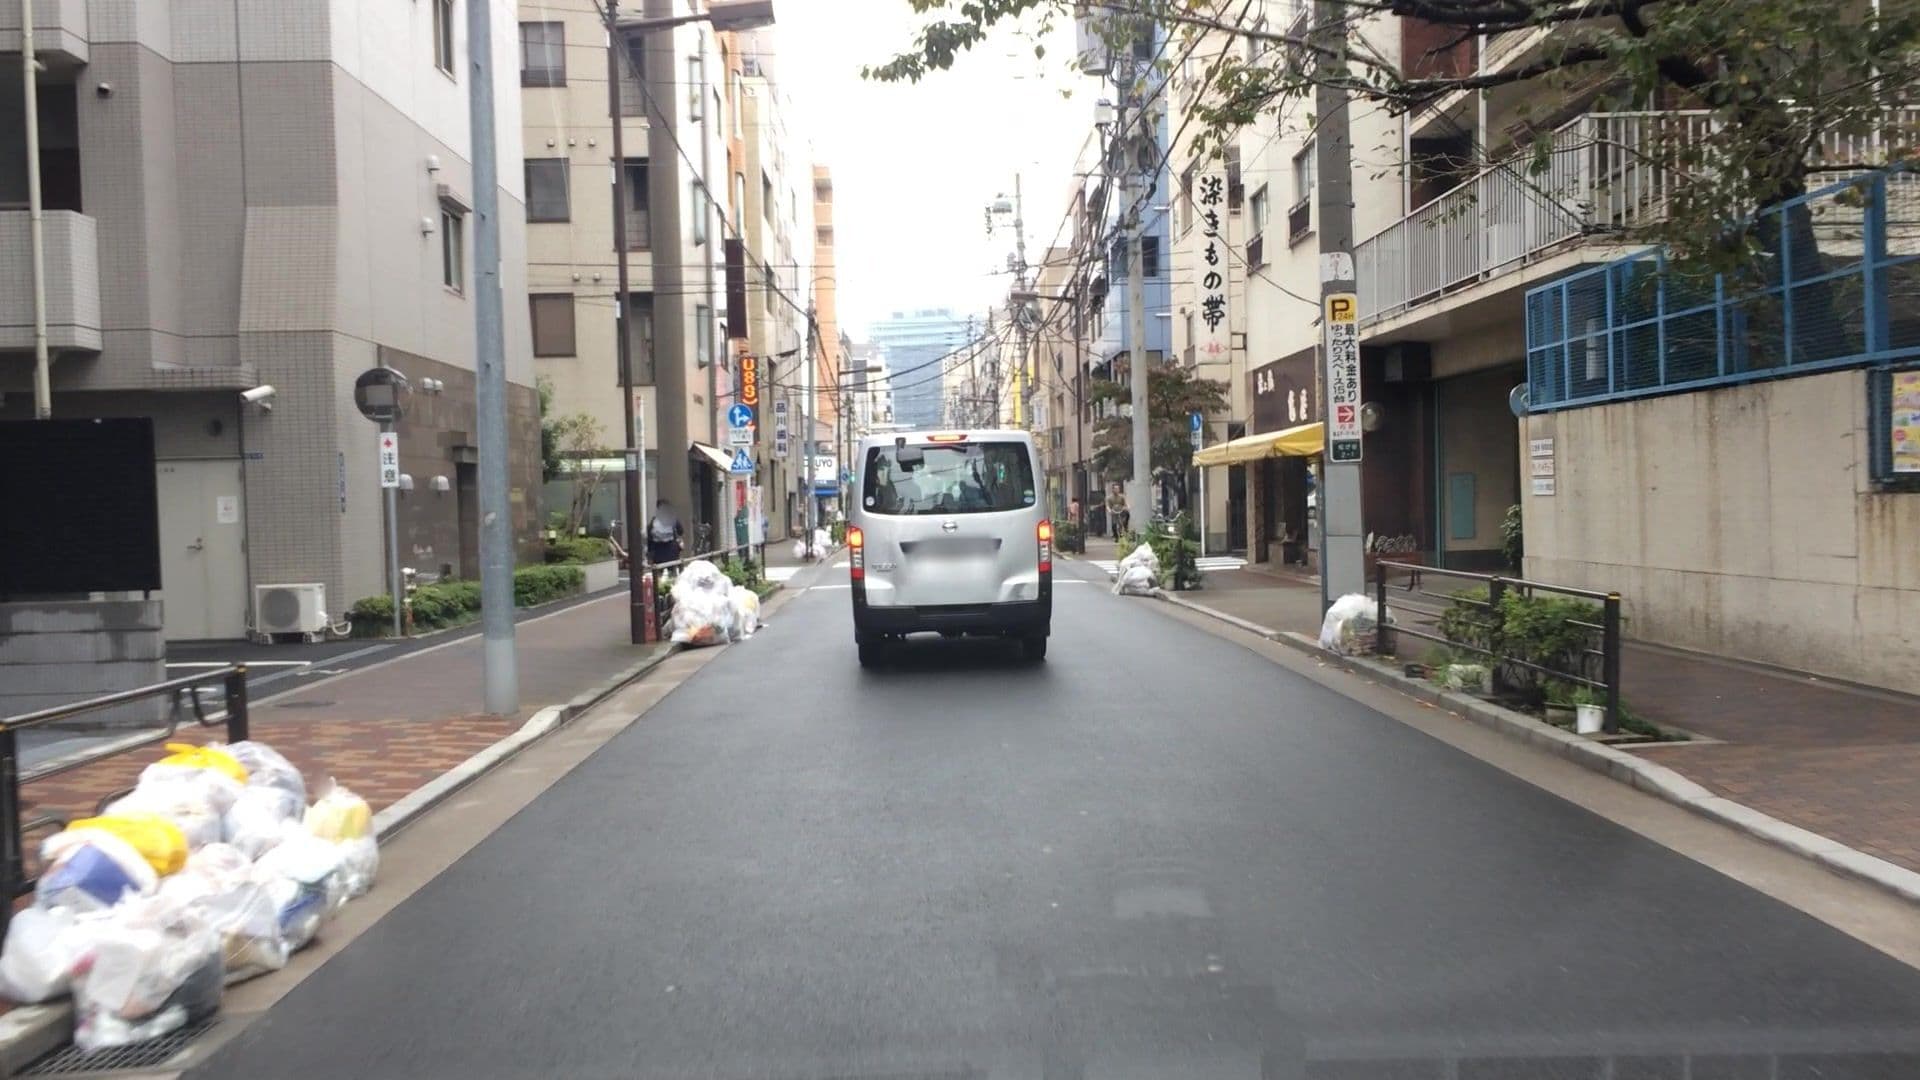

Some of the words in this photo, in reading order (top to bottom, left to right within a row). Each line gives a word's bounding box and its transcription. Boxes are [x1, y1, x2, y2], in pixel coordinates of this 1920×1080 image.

[1199, 174, 1226, 334] 染きもの帯
[1331, 299, 1350, 321] P
[1331, 324, 1345, 403] ゆったりスペース15台
[1345, 324, 1357, 403] 最大料金あり
[383, 452, 396, 483] 注意
